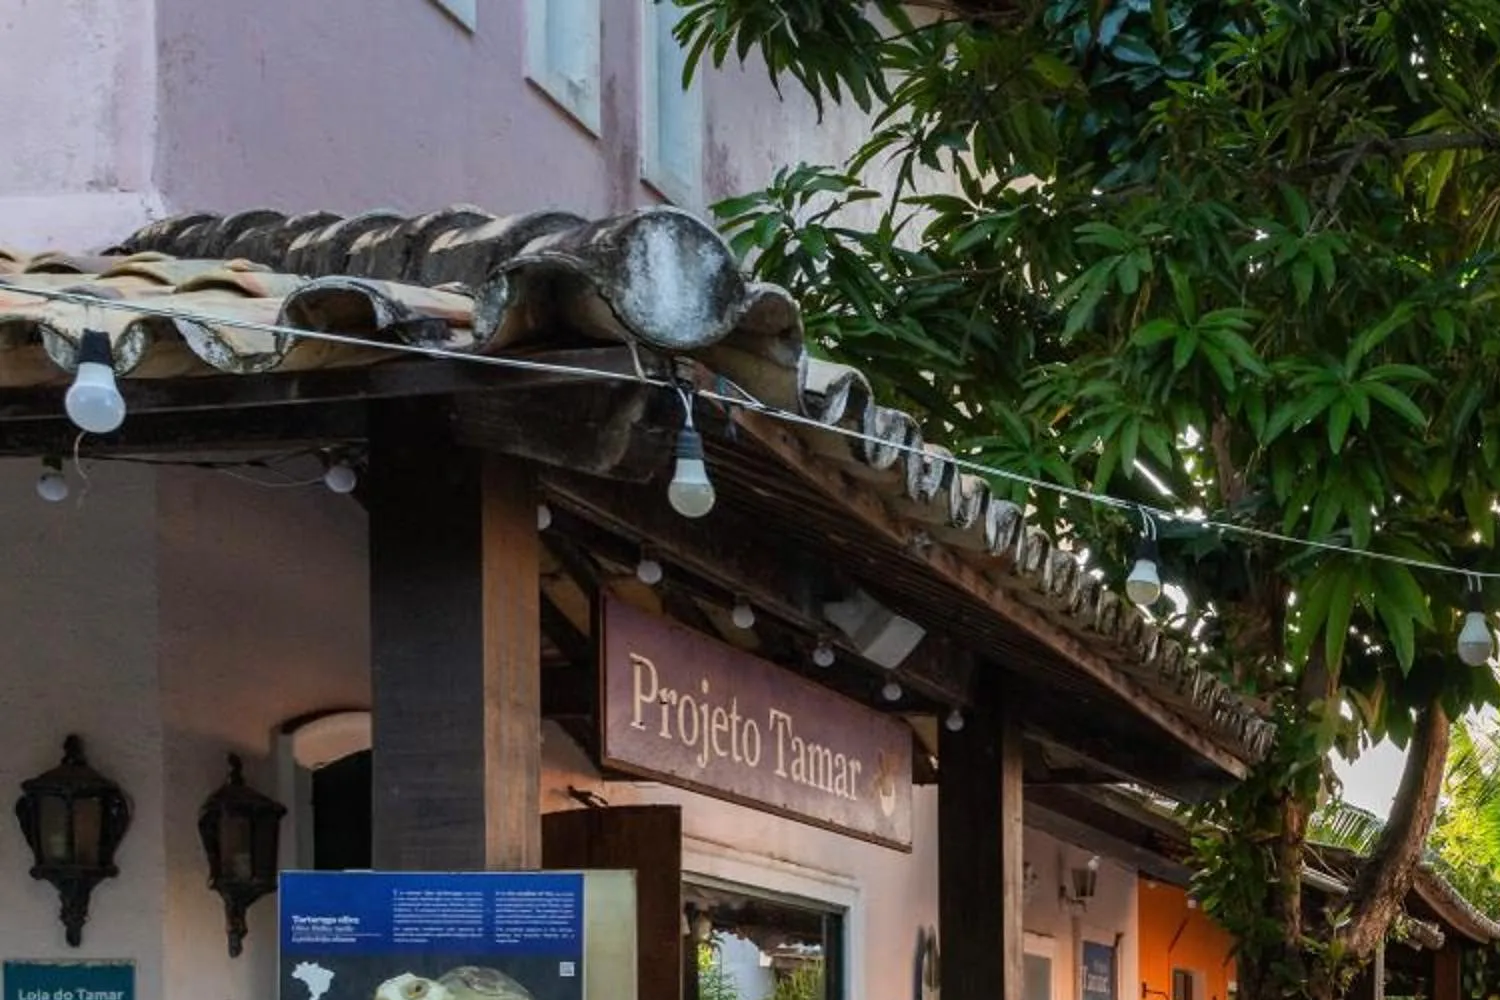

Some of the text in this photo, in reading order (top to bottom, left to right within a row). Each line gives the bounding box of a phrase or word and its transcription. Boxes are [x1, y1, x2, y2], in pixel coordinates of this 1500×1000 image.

[629, 652, 861, 801] Projeto Tamar
[53, 988, 73, 1000] do
[76, 988, 124, 1000] Tamar
